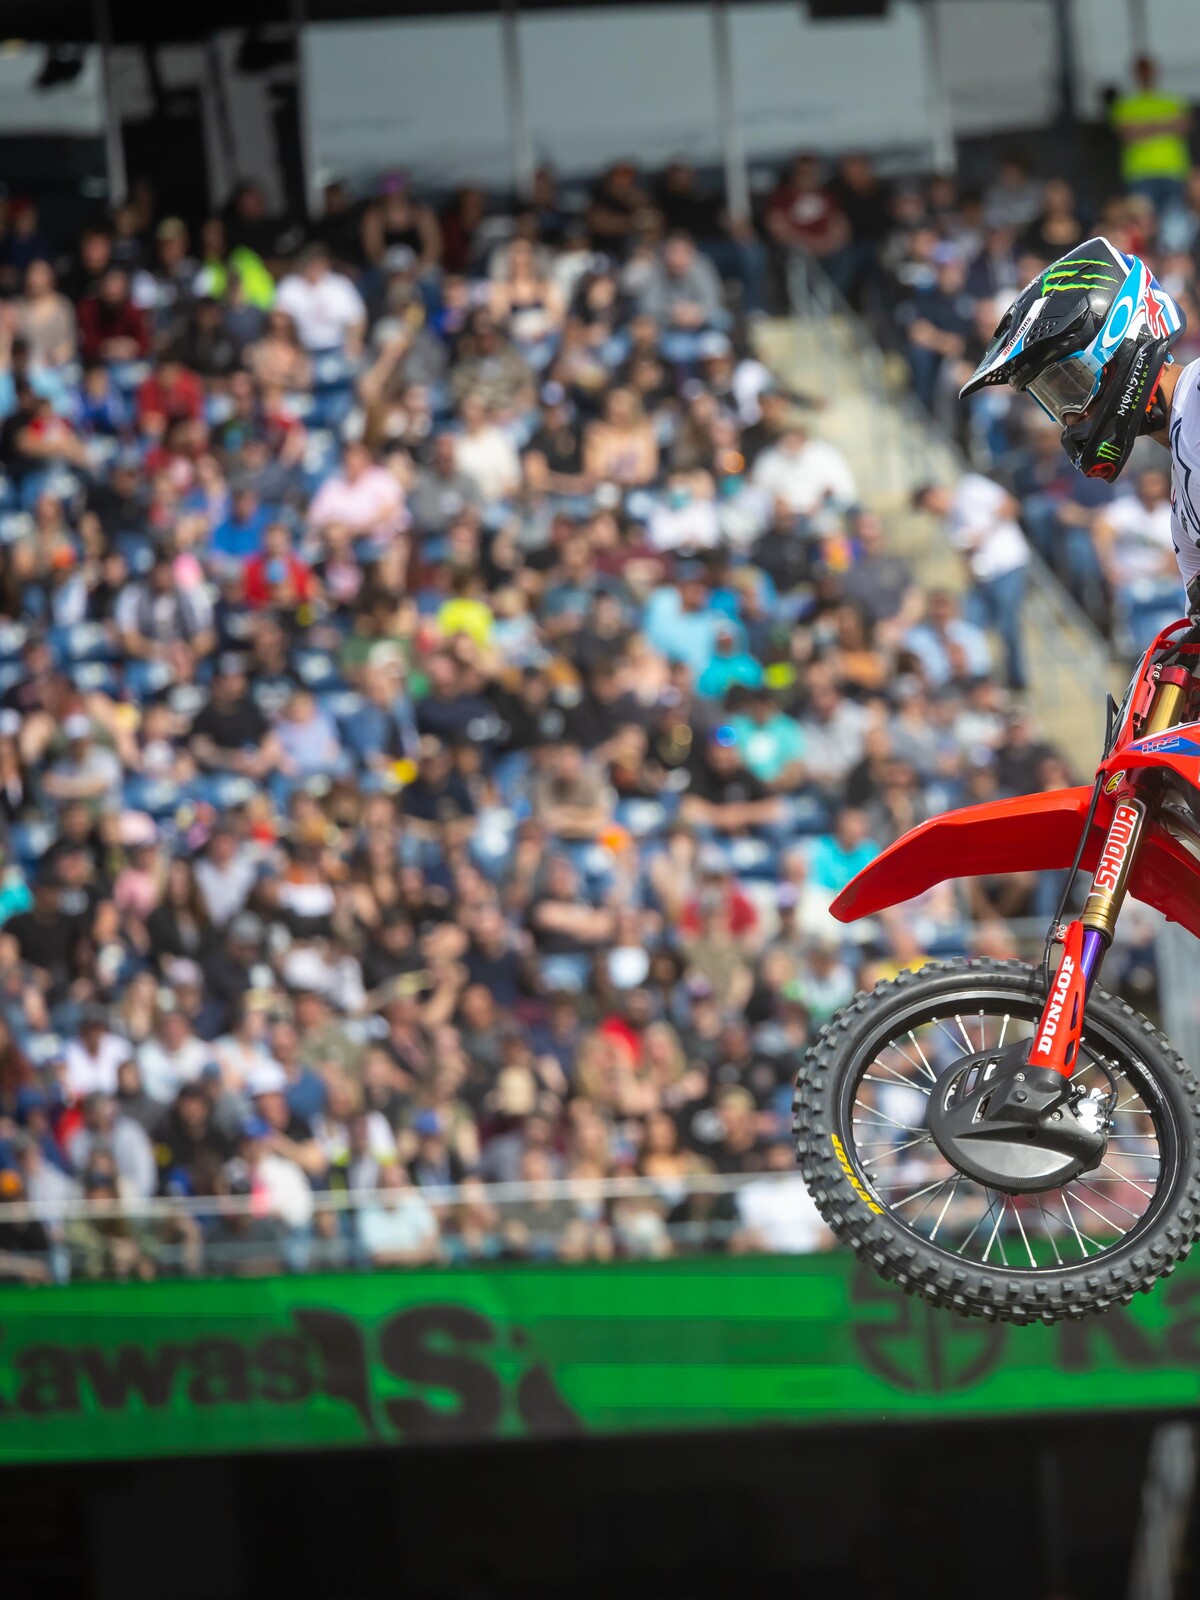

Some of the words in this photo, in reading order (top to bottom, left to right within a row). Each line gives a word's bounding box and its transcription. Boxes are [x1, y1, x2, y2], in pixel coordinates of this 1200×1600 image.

[1131, 363, 1150, 410] ENERGY
[1094, 805, 1139, 892] SHOWA
[1038, 956, 1075, 1055] DUNLOP
[831, 1133, 885, 1216] DUNLOP
